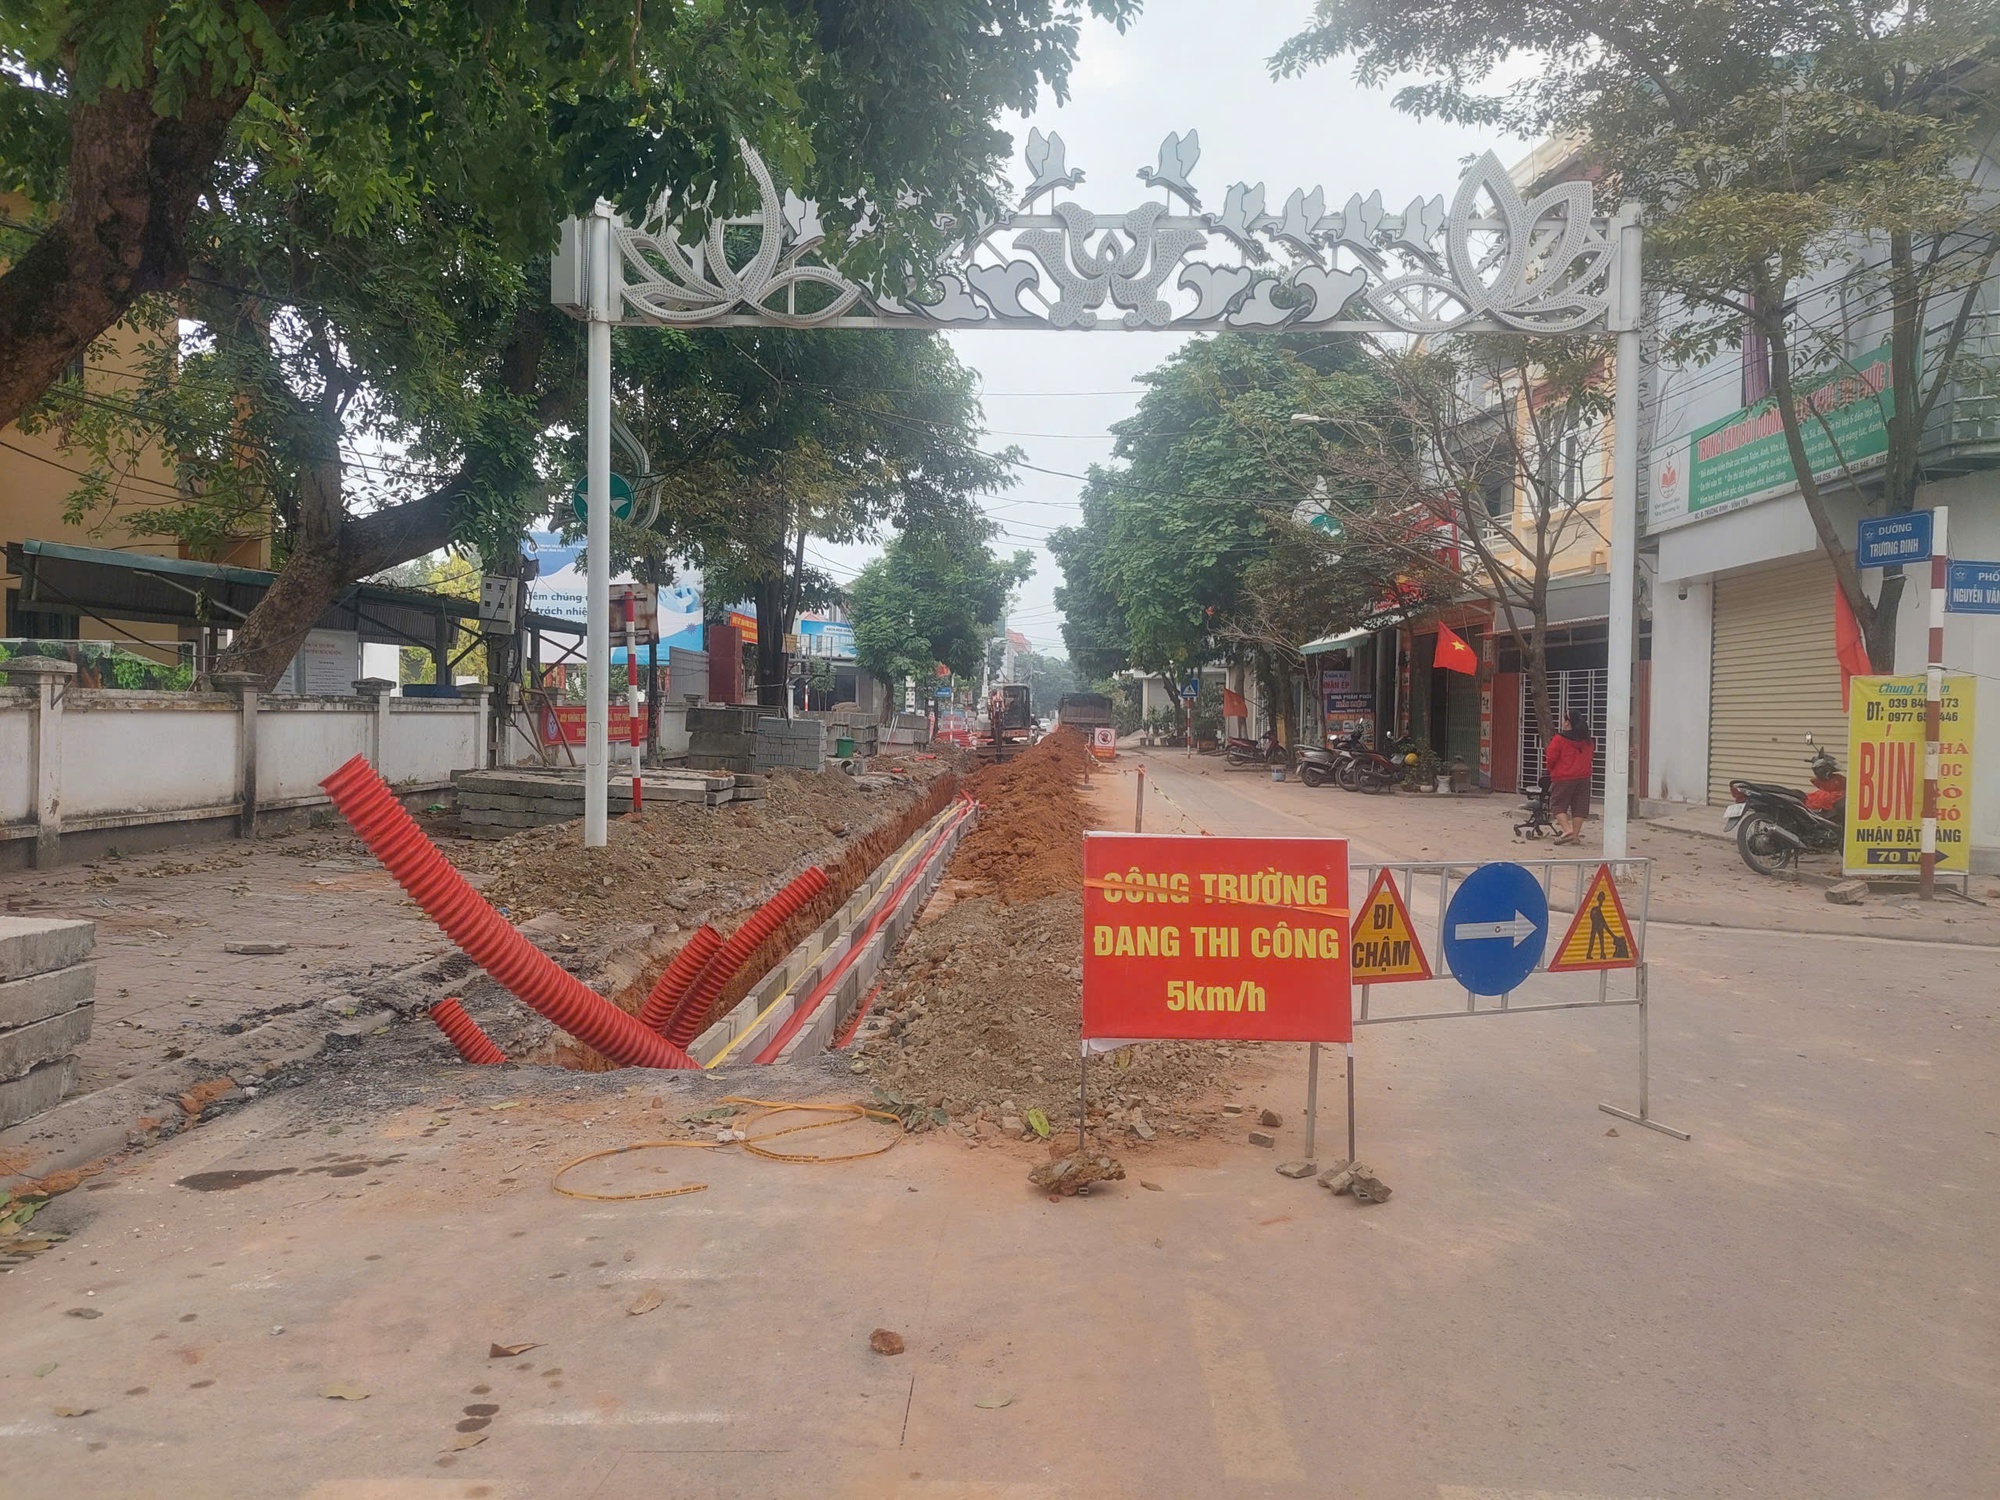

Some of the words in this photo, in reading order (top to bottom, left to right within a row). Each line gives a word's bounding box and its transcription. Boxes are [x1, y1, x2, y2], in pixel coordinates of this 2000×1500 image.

[1697, 430, 1721, 463] TRUNG
[1722, 421, 1740, 454] TÂM
[1740, 412, 1755, 448] BỒI
[1879, 683, 1914, 695] Chung
[1867, 701, 1885, 721] ĐT:
[1889, 699, 1908, 708] 039
[1888, 712, 1914, 722] 0977
[1858, 724, 1915, 821] BÚN
[1856, 825, 1893, 845] NHẬN
[1935, 825, 1961, 843] ÀNG
[1876, 851, 1900, 862] 70
[1103, 866, 1189, 903] CÔNG
[1200, 867, 1327, 905] TRƯỜNG
[1373, 904, 1394, 929] ĐI
[1093, 925, 1180, 957] ĐANG
[1190, 926, 1240, 958] THI
[1251, 921, 1339, 959] CÔNG
[1352, 935, 1411, 972] CHẬM
[1166, 980, 1266, 1013] 5km/h
